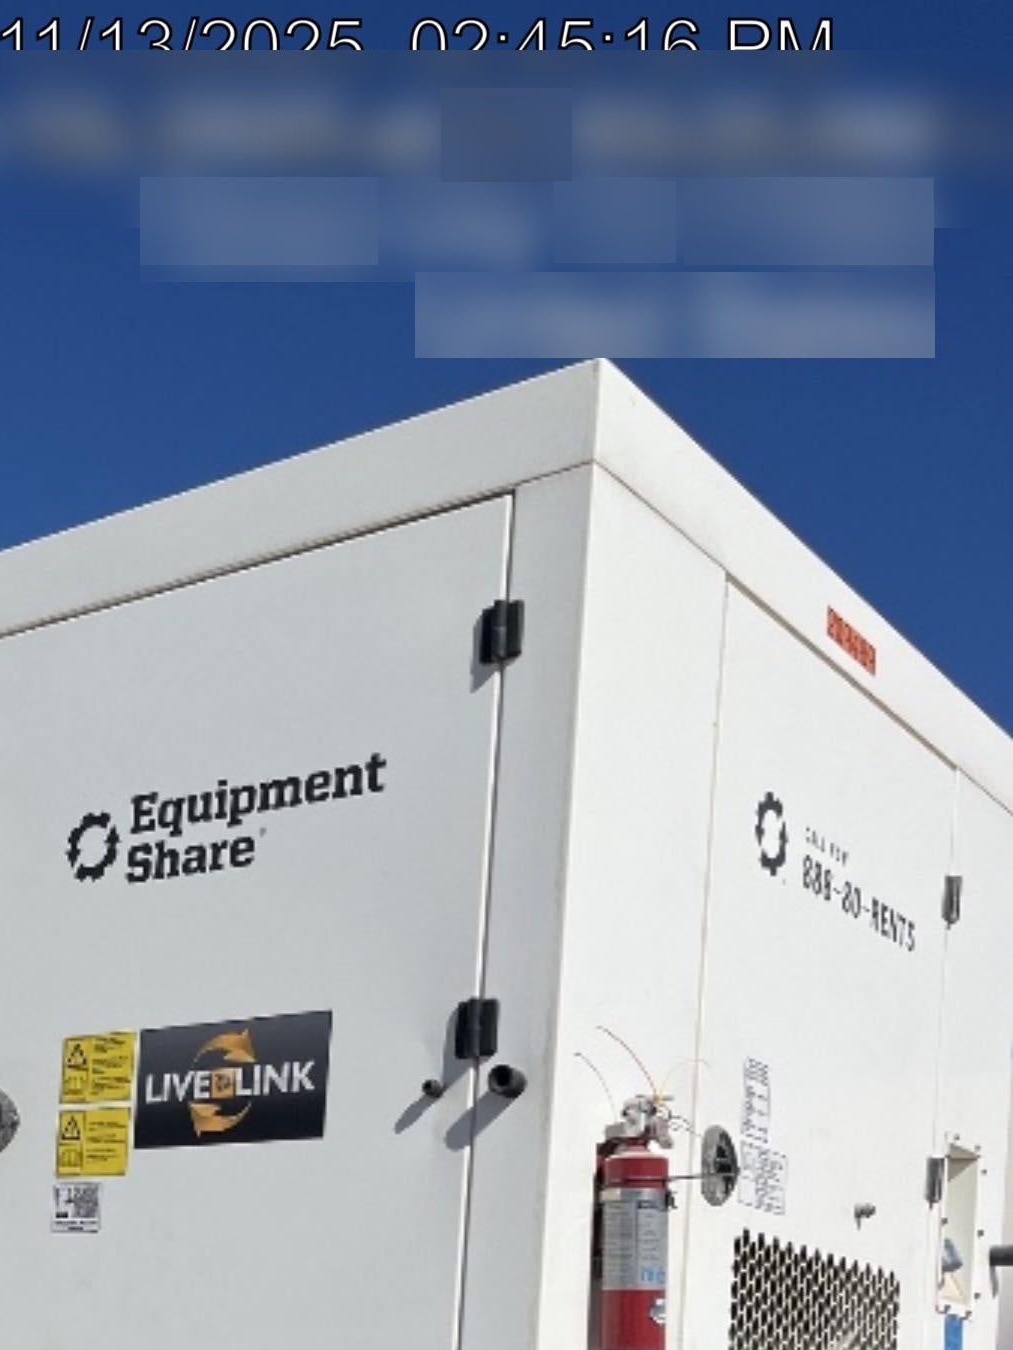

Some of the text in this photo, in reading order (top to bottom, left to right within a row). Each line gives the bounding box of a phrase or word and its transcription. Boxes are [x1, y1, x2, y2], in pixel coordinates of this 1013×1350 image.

[130, 752, 387, 837] Equipment
[125, 835, 255, 883] Share
[802, 853, 916, 952] 888-80-RENTS
